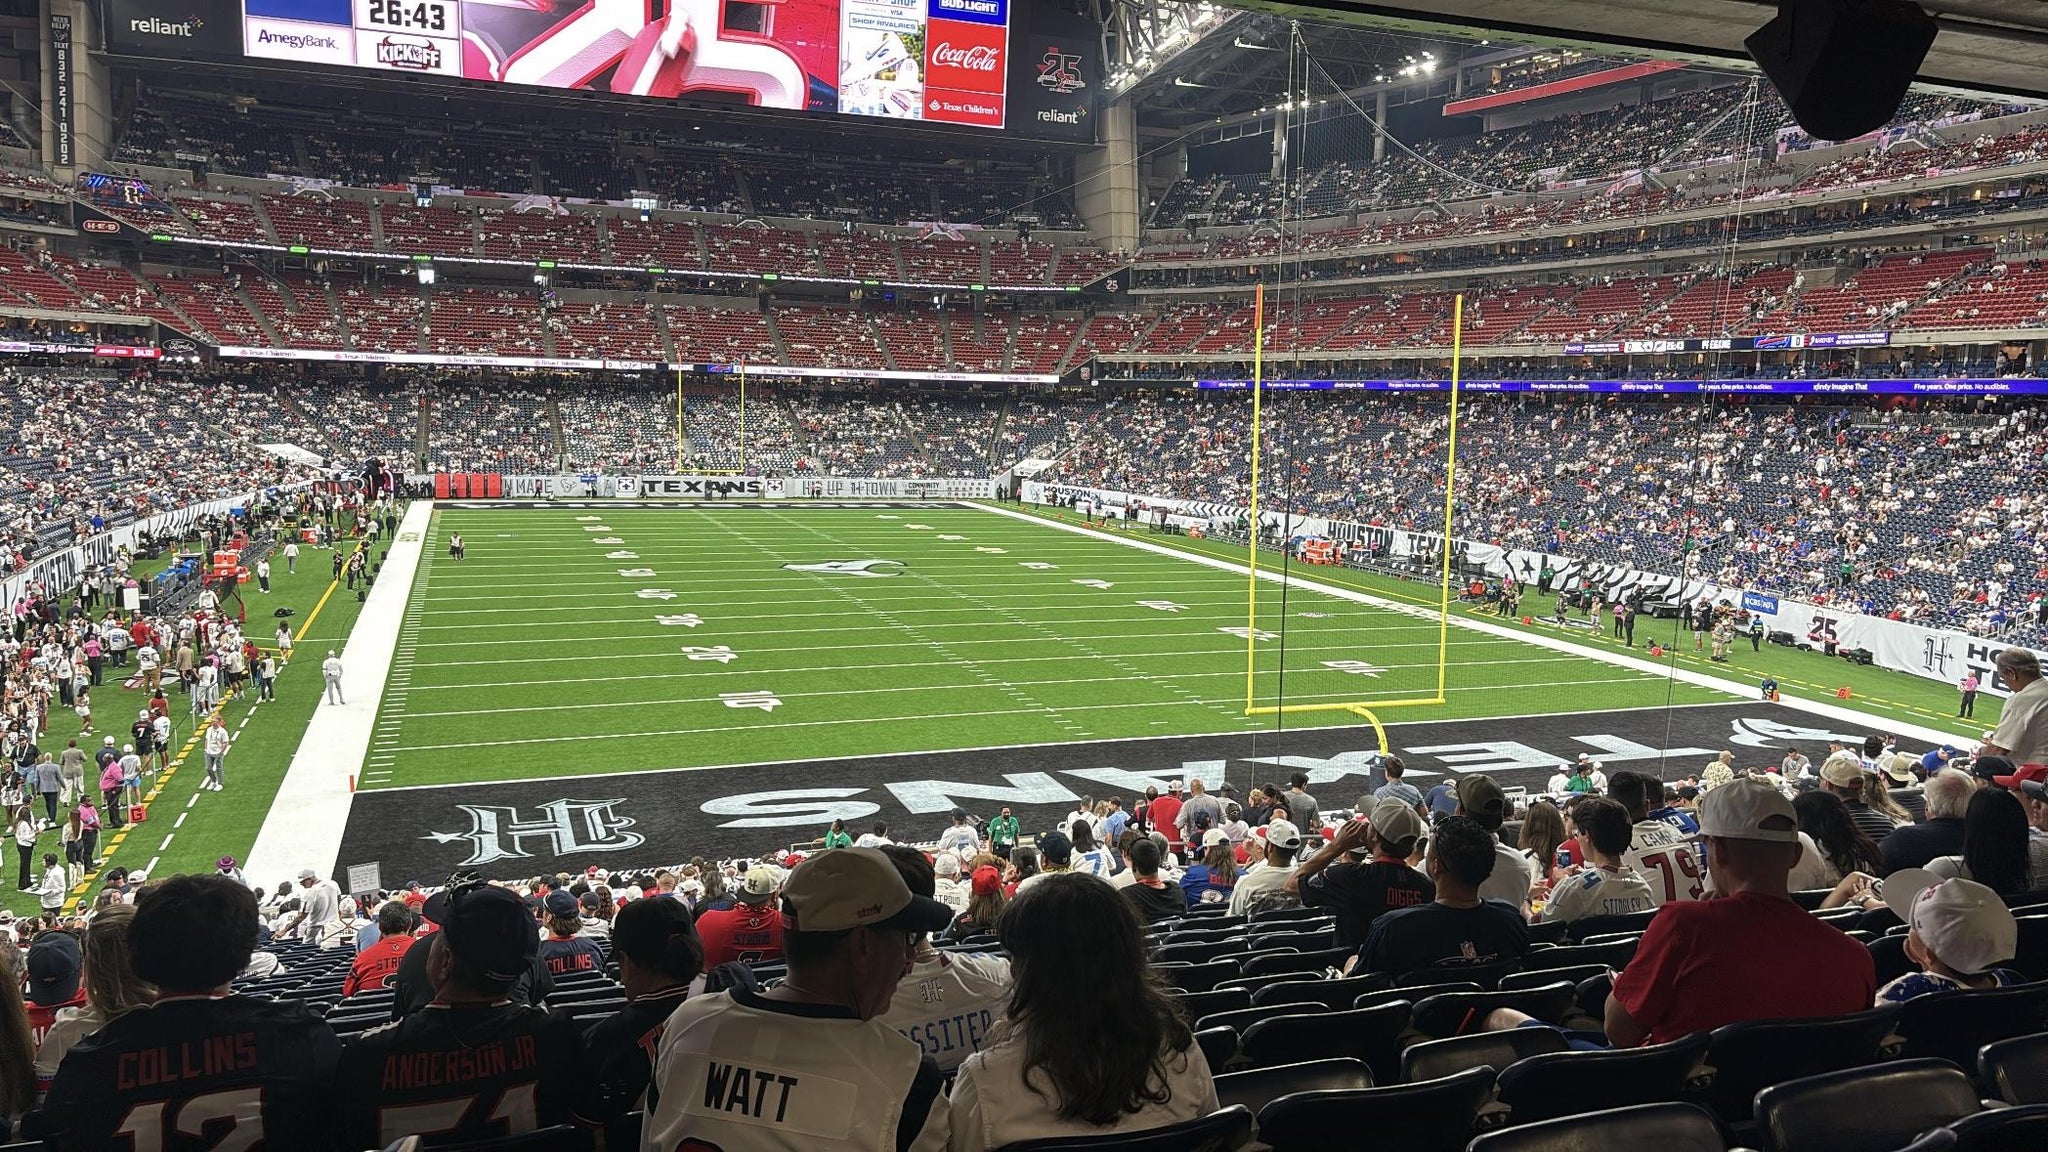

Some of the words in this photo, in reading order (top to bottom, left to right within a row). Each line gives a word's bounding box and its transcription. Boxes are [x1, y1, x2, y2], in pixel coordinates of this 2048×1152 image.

[370, 0, 445, 31] 26:43
[966, 0, 997, 13] LIGHT
[131, 17, 193, 37] reliant
[852, 17, 875, 25] SHOP
[877, 19, 917, 30] RIVALRIES
[54, 41, 69, 49] TEXT
[942, 102, 962, 113] Texas
[963, 104, 999, 116] Children's
[1037, 108, 1078, 124] reliant
[1813, 383, 1830, 391] xfinity
[1831, 383, 1854, 391] Imagine
[643, 480, 761, 493] TEXANS
[1043, 485, 1092, 498] HOUSTON
[1328, 520, 1394, 553] HOUSTON
[1407, 533, 1470, 553] TEXANS
[82, 533, 114, 567] TEXANS
[32, 549, 77, 600] HOUSTON
[137, 727, 146, 737] 7
[699, 732, 1722, 829] TEXANS
[132, 807, 142, 821] G
[1084, 852, 1103, 877] 7
[1641, 847, 1705, 901] 79
[1386, 886, 1424, 908] DIGGS
[116, 1031, 259, 1092] COLLINS
[380, 1040, 508, 1091] ANDERSON
[510, 1032, 538, 1073] JR
[703, 1060, 800, 1124] WATT
